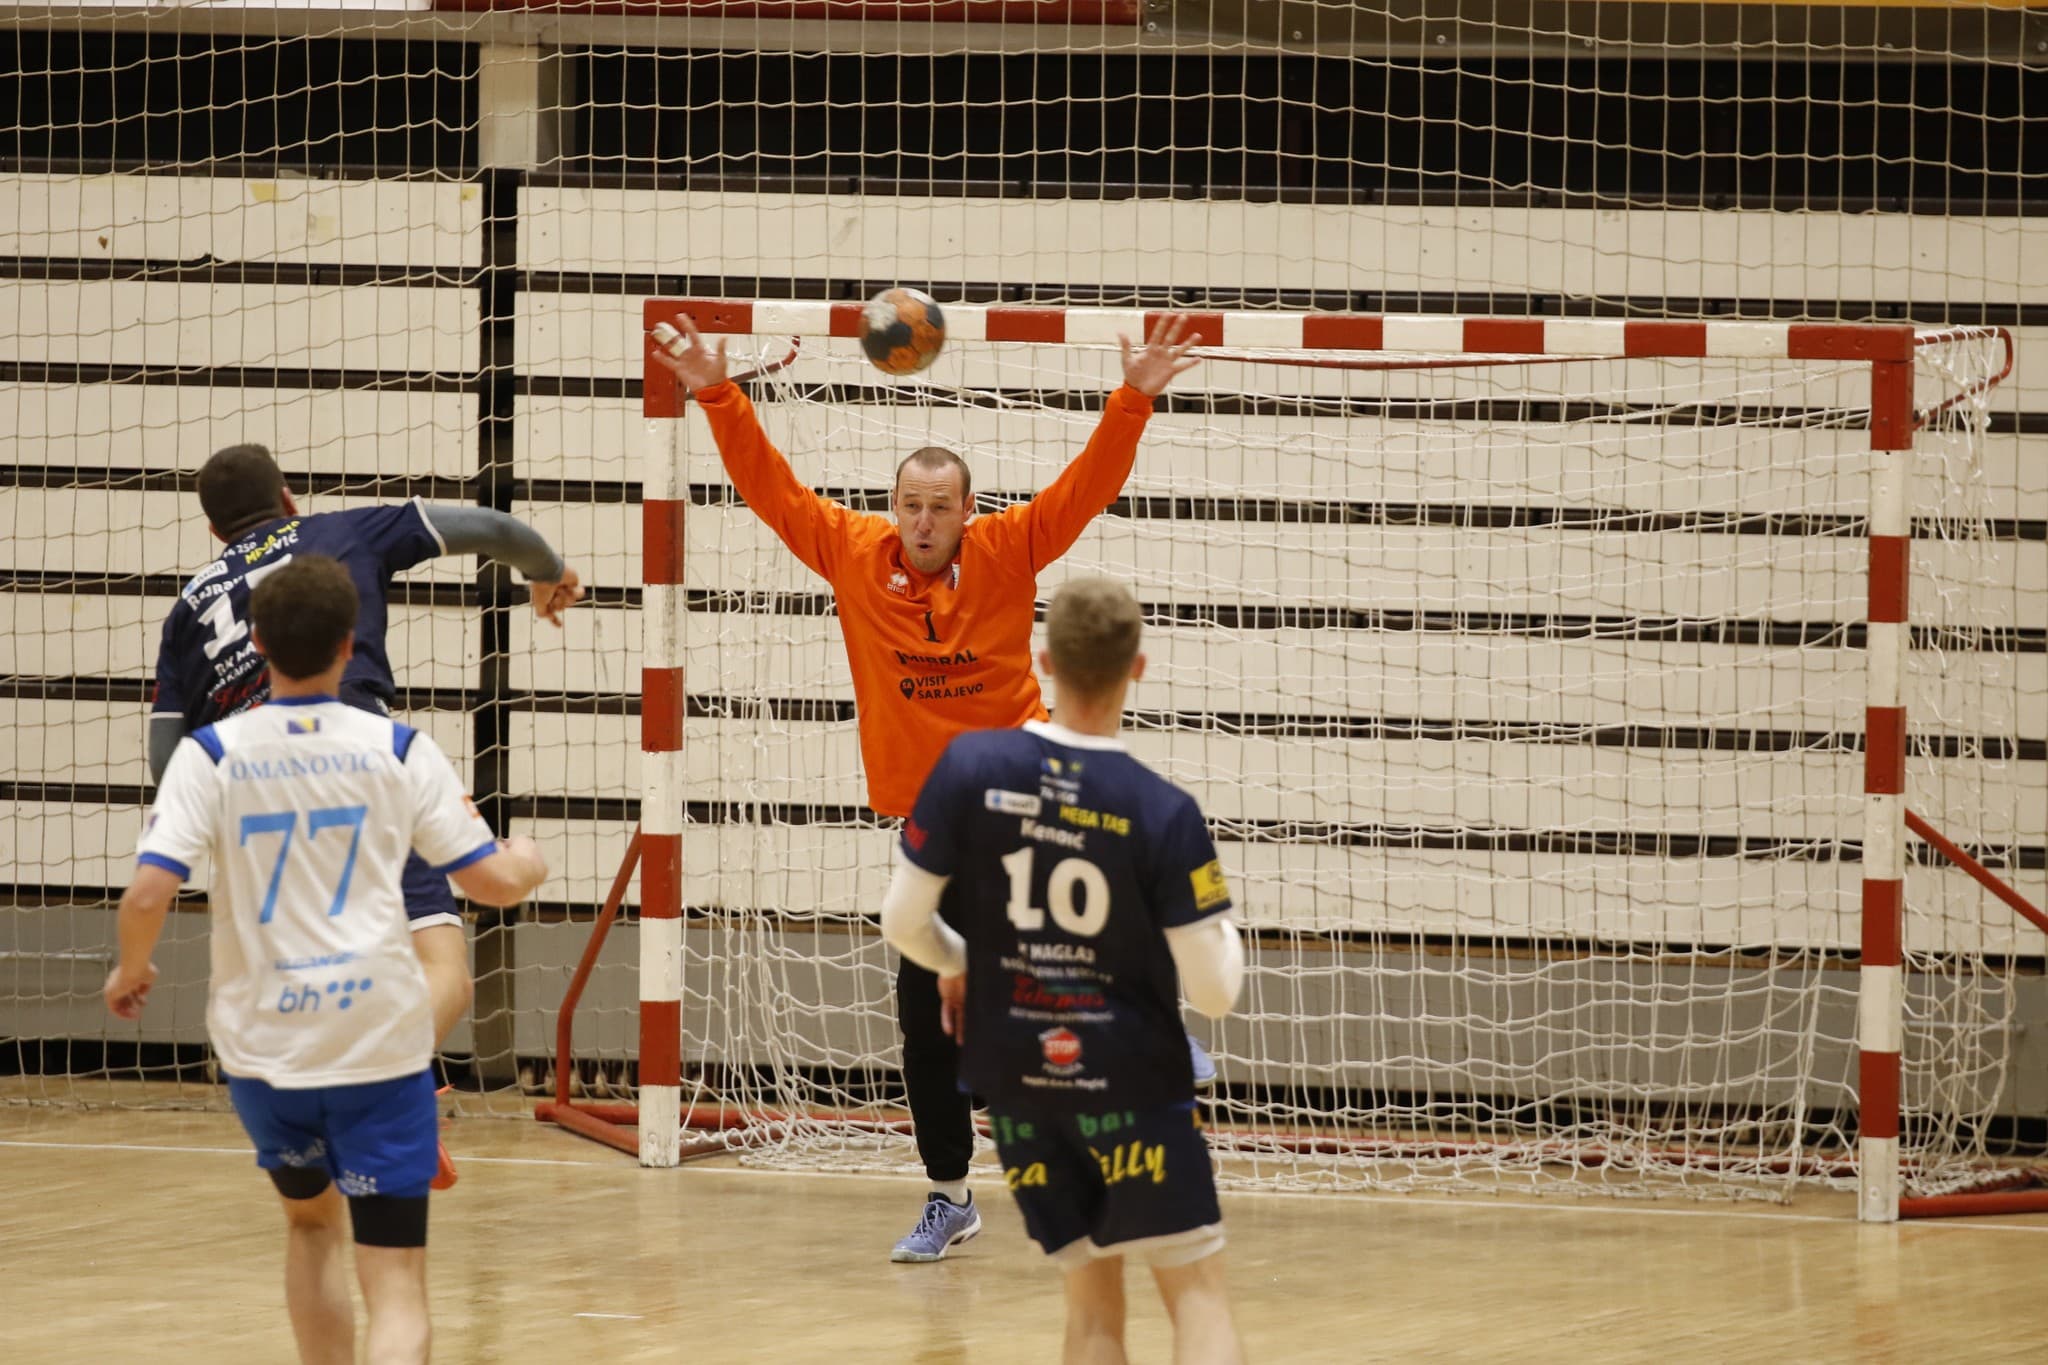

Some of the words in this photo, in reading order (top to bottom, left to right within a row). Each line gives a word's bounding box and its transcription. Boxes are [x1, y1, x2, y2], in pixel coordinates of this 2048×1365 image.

[924, 610, 942, 643] 1
[916, 675, 947, 687] VISIT
[917, 683, 984, 699] SARAJEVO
[240, 805, 368, 924] 77
[1001, 845, 1110, 937] 10
[277, 983, 321, 1013] bh
